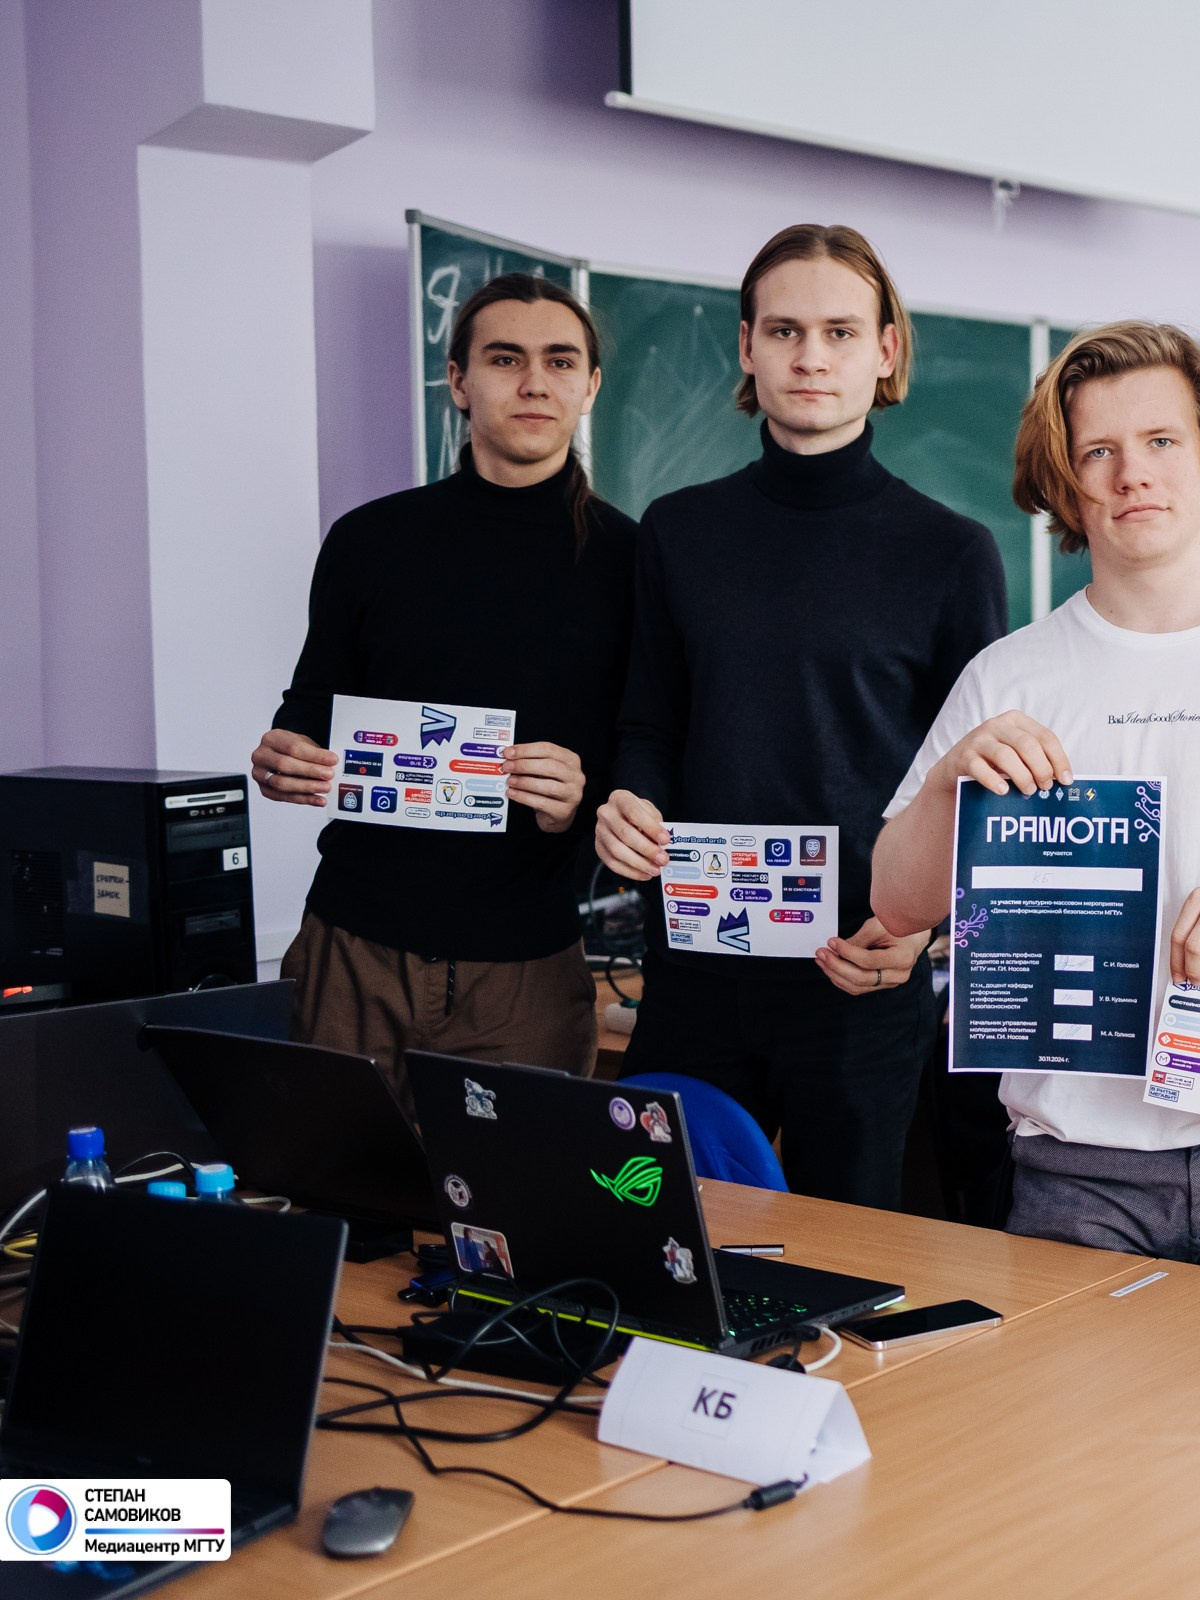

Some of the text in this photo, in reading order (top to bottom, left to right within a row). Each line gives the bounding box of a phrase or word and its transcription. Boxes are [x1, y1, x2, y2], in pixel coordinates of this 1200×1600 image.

[986, 816, 1128, 844] ГРАМОТА
[232, 853, 239, 865] 6
[692, 1386, 737, 1419] КБ
